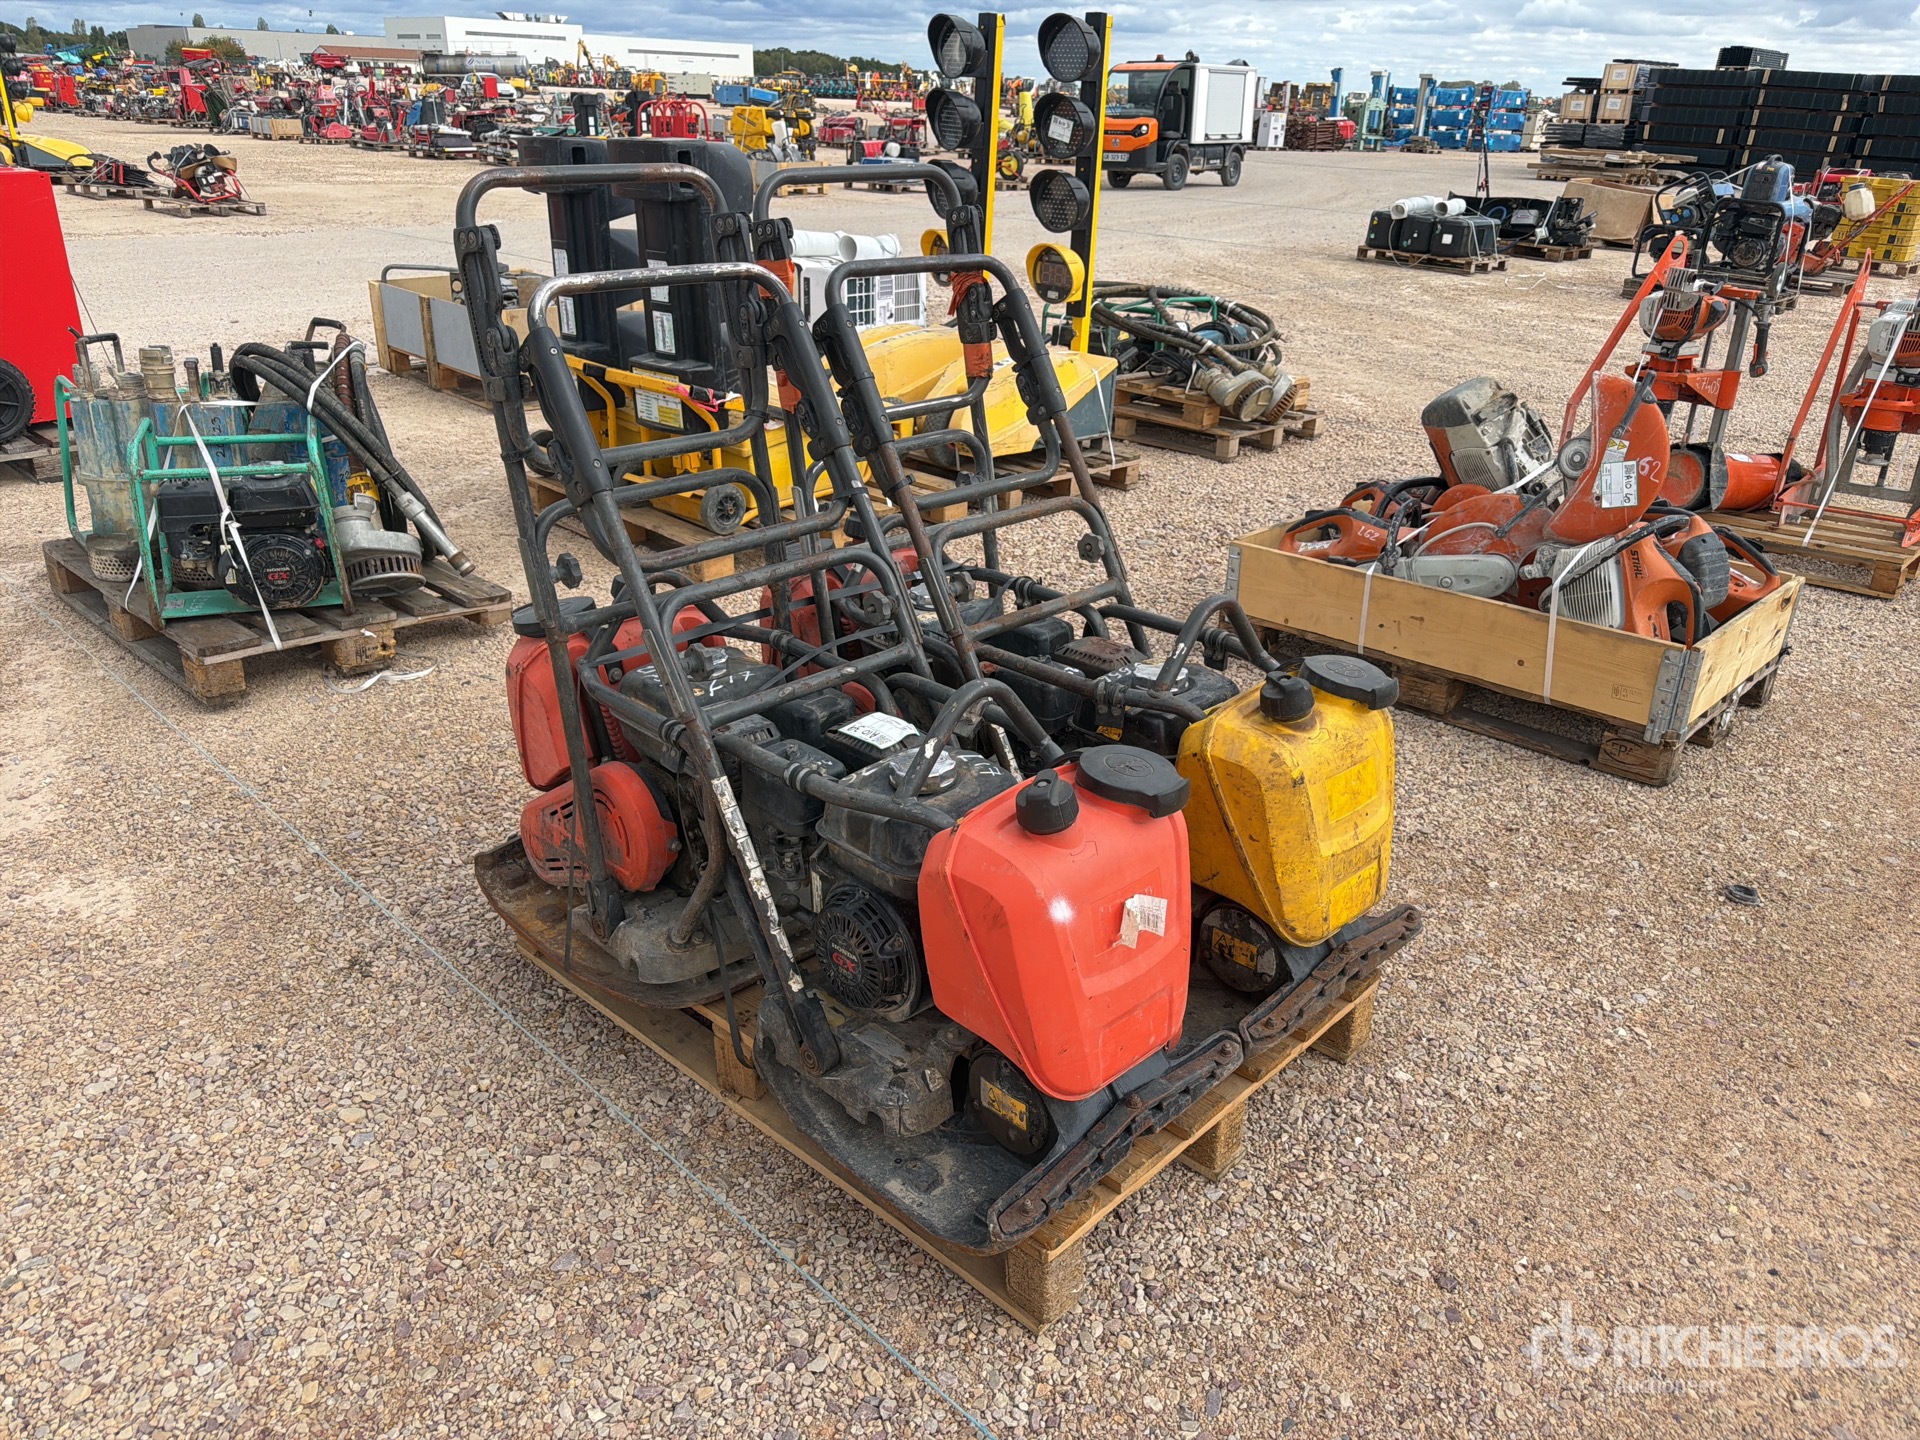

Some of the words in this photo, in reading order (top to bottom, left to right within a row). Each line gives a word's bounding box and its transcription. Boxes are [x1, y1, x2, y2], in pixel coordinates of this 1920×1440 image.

[1630, 549, 1643, 579] STIHL
[267, 572, 290, 580] GX
[831, 942, 858, 962] HONDA
[832, 952, 858, 974] GX
